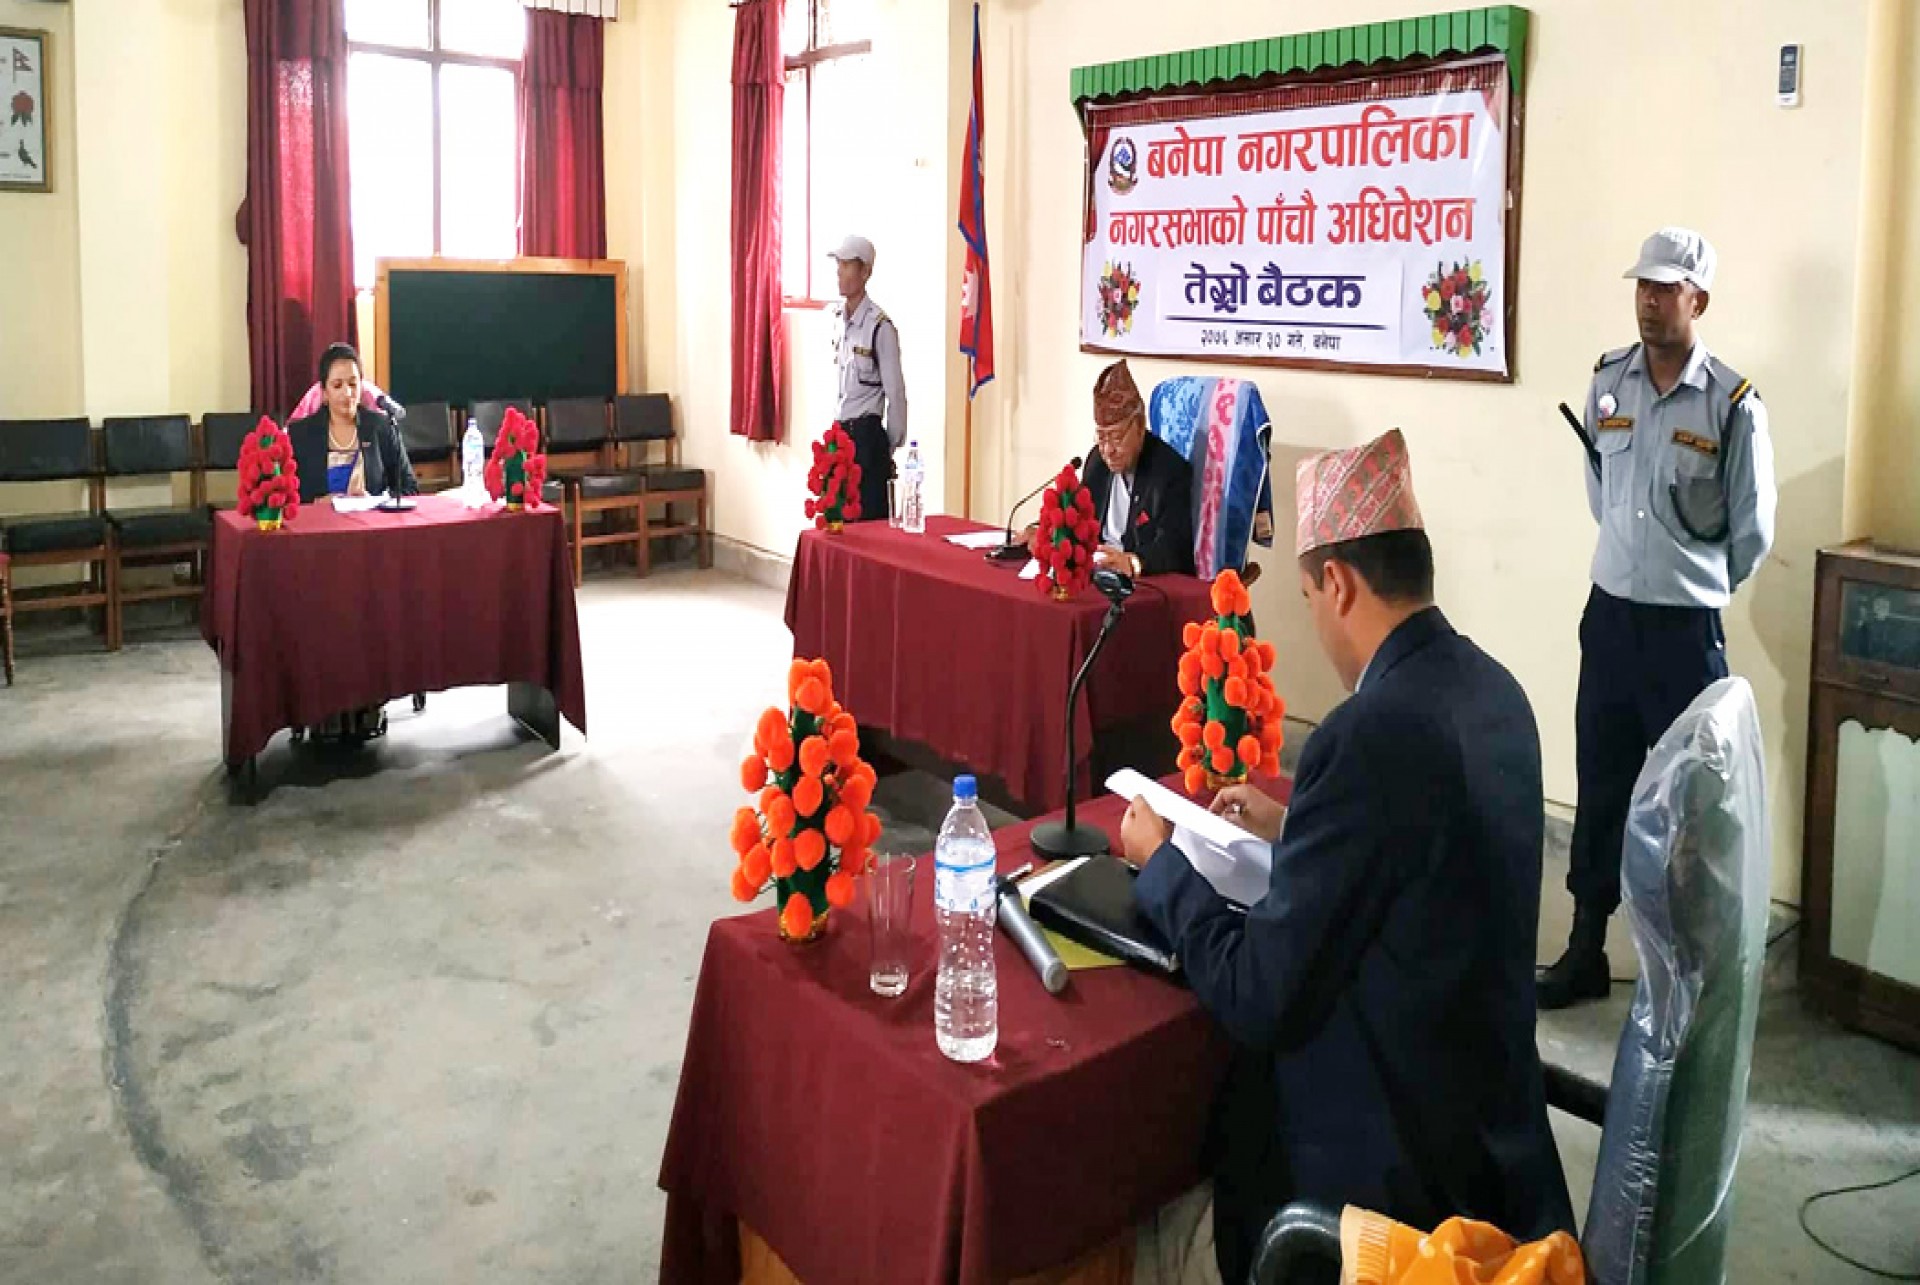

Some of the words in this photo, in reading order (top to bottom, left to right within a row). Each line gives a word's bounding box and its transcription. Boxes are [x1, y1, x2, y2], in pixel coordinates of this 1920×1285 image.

[1147, 127, 1226, 179] बनेपा
[1237, 104, 1475, 174] नगरपालिका
[1109, 195, 1249, 249] नगरसभाको
[1327, 185, 1477, 246] अधिवेशन
[1184, 261, 1250, 313] तेस्रो
[1256, 261, 1366, 309] बैठक
[1266, 331, 1282, 351] ३०
[1312, 329, 1341, 350] बनेपा
